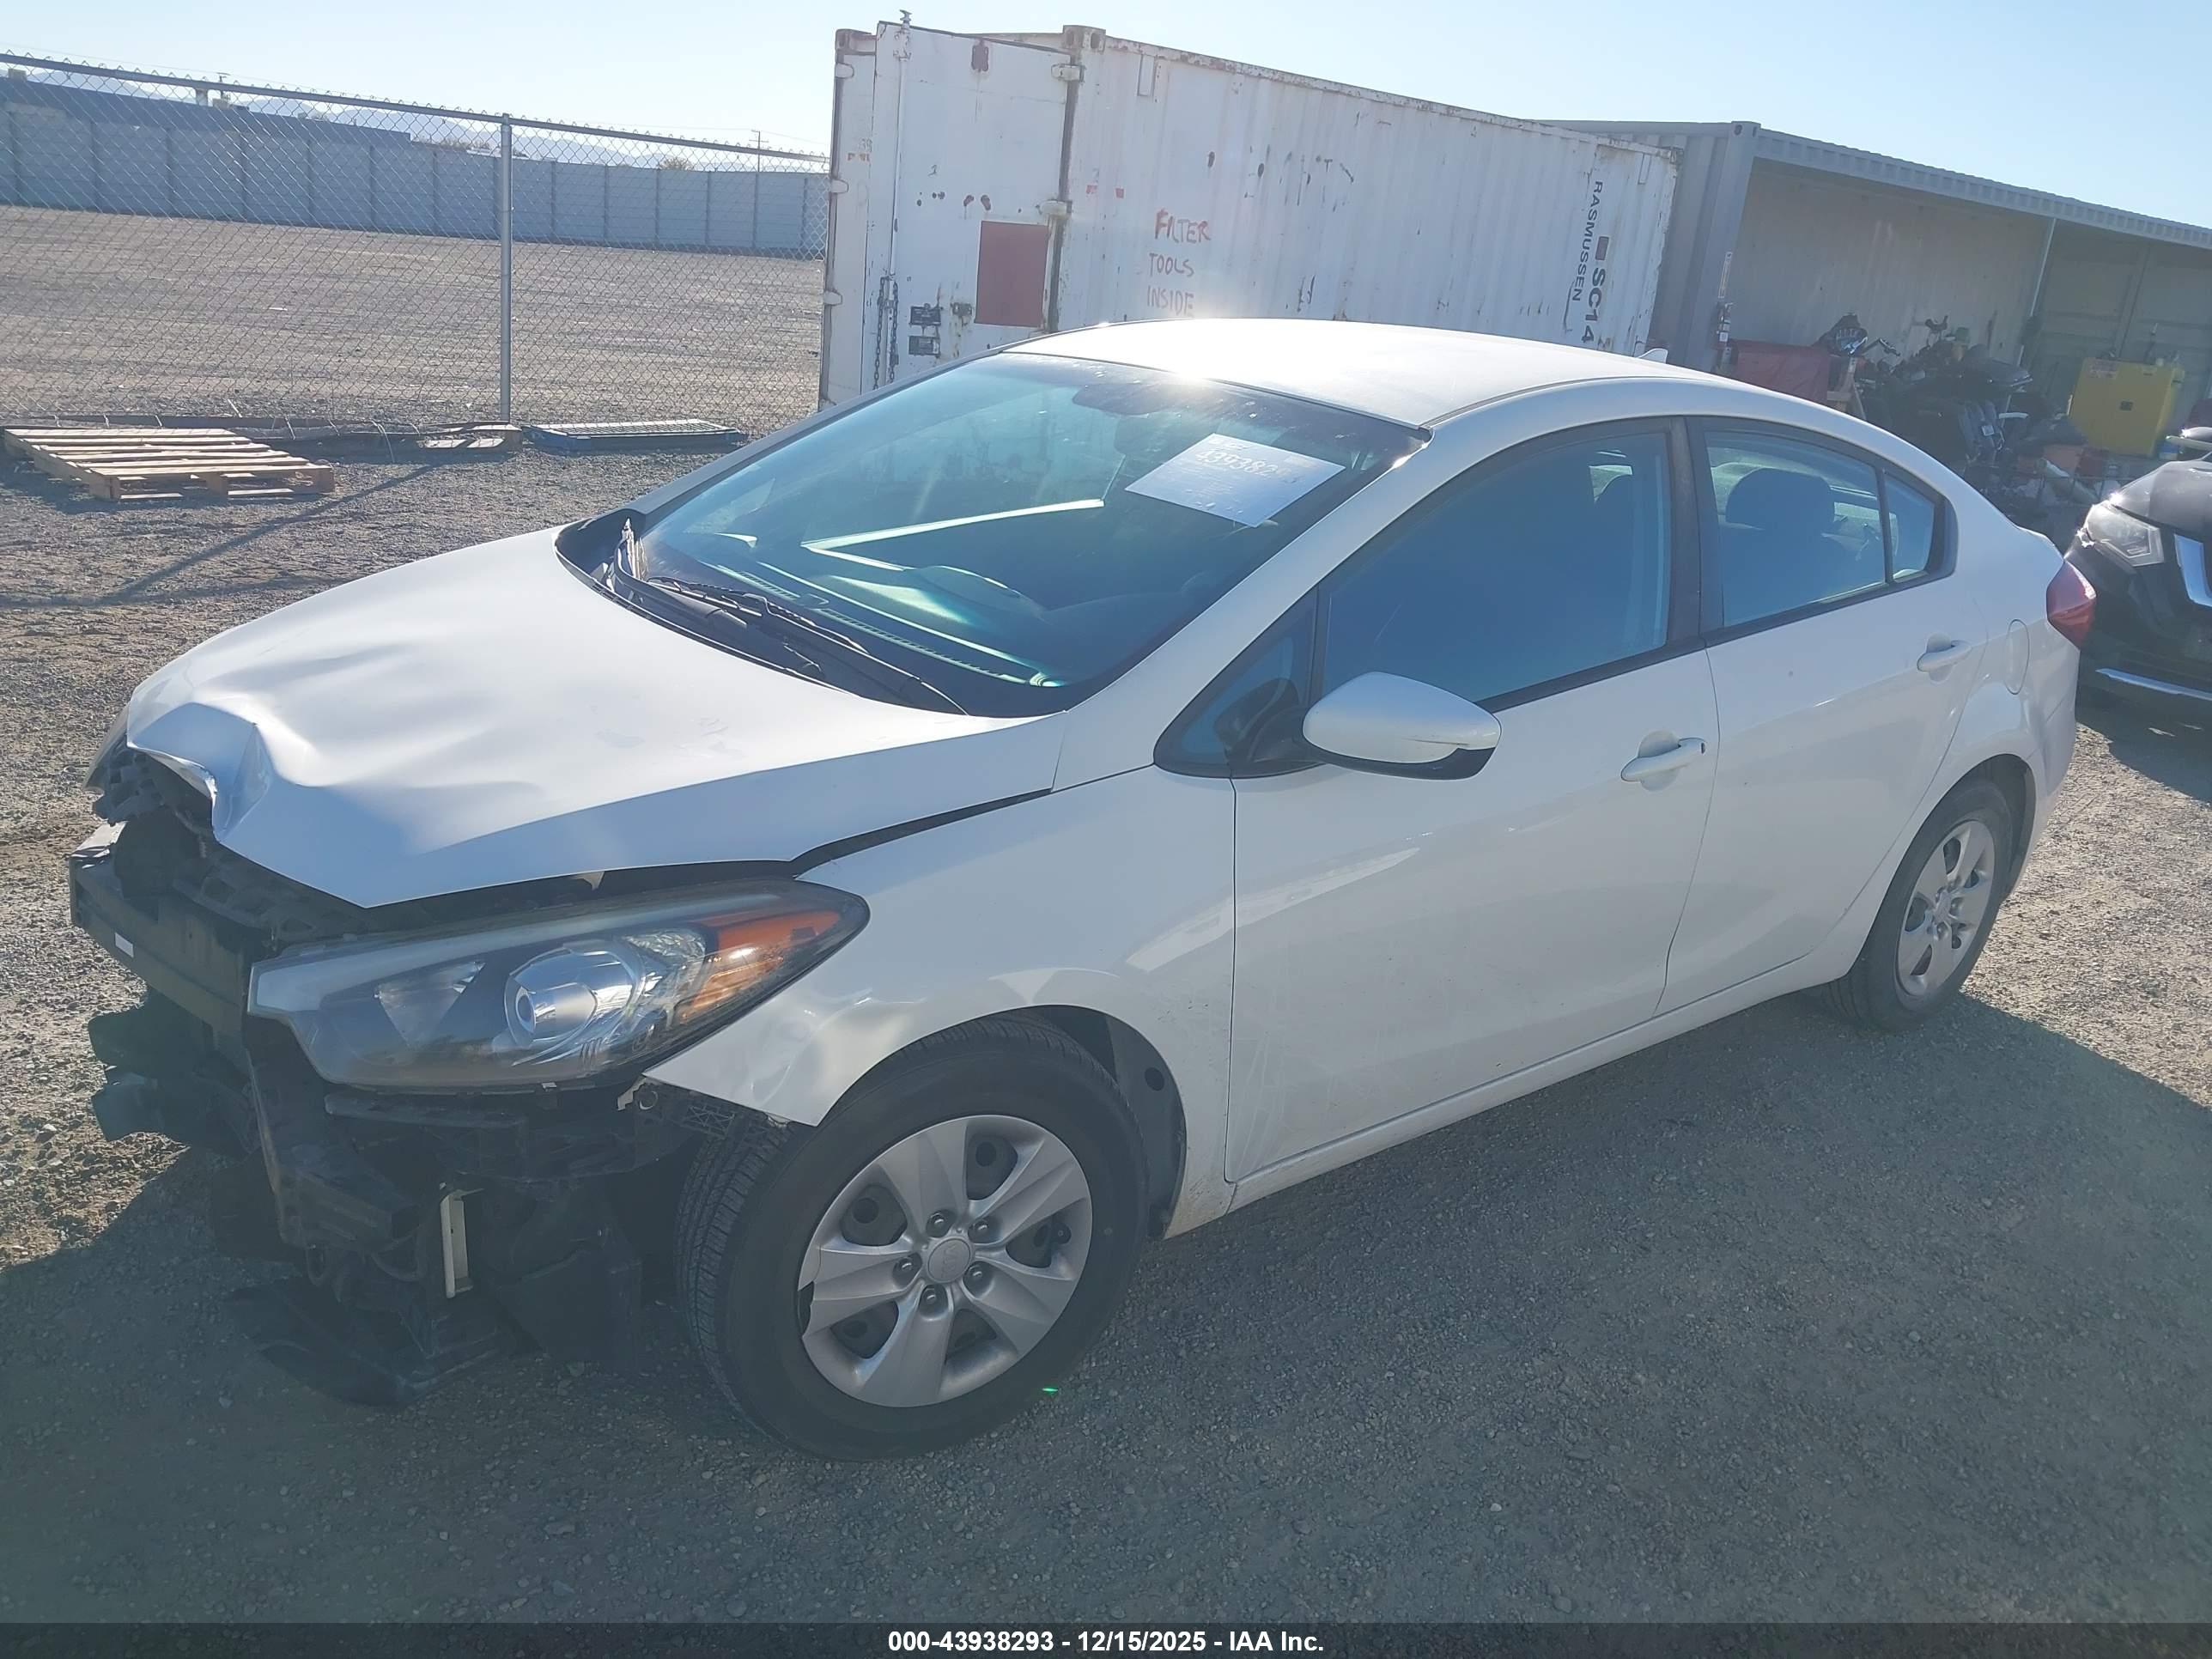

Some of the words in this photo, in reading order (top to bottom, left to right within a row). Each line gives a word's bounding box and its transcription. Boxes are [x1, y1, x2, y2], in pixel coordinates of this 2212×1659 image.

[1155, 207, 1212, 244] FILTER
[1572, 180, 1603, 301] RASMUSSEN
[1149, 252, 1194, 277] TOOLS
[1147, 284, 1194, 318] INSIDE
[1581, 267, 1606, 343] SC14
